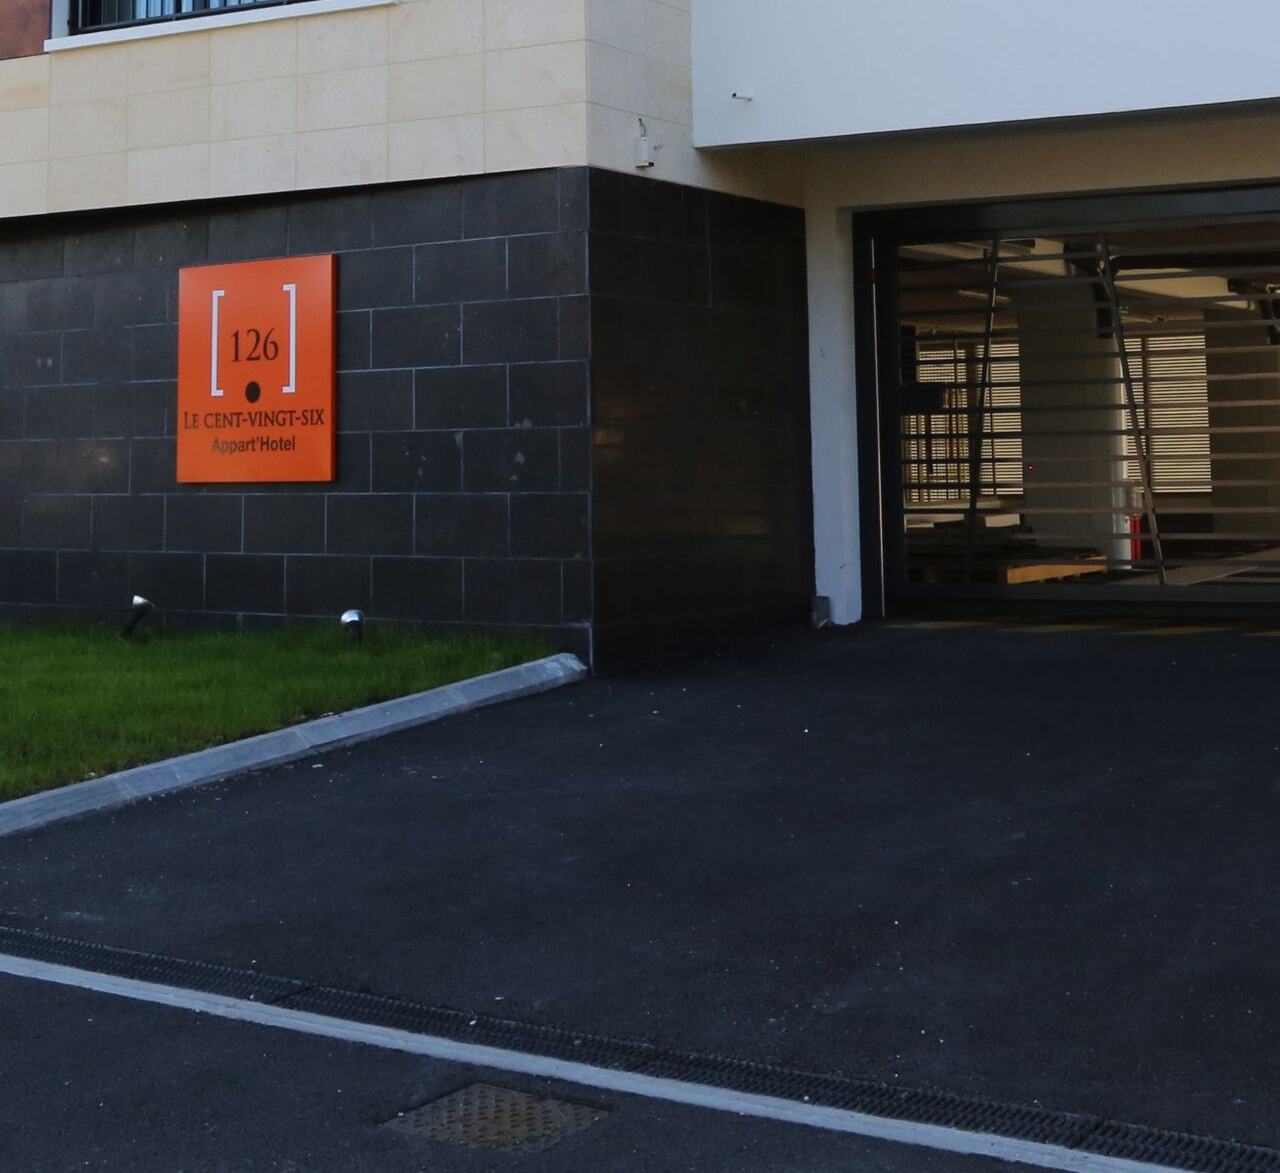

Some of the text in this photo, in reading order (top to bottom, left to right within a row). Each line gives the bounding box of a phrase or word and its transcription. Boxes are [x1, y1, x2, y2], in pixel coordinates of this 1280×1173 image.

[230, 328, 280, 363] 126
[203, 409, 325, 428] CENT-VINGT-SIX
[211, 435, 296, 455] Appart'Hotel
